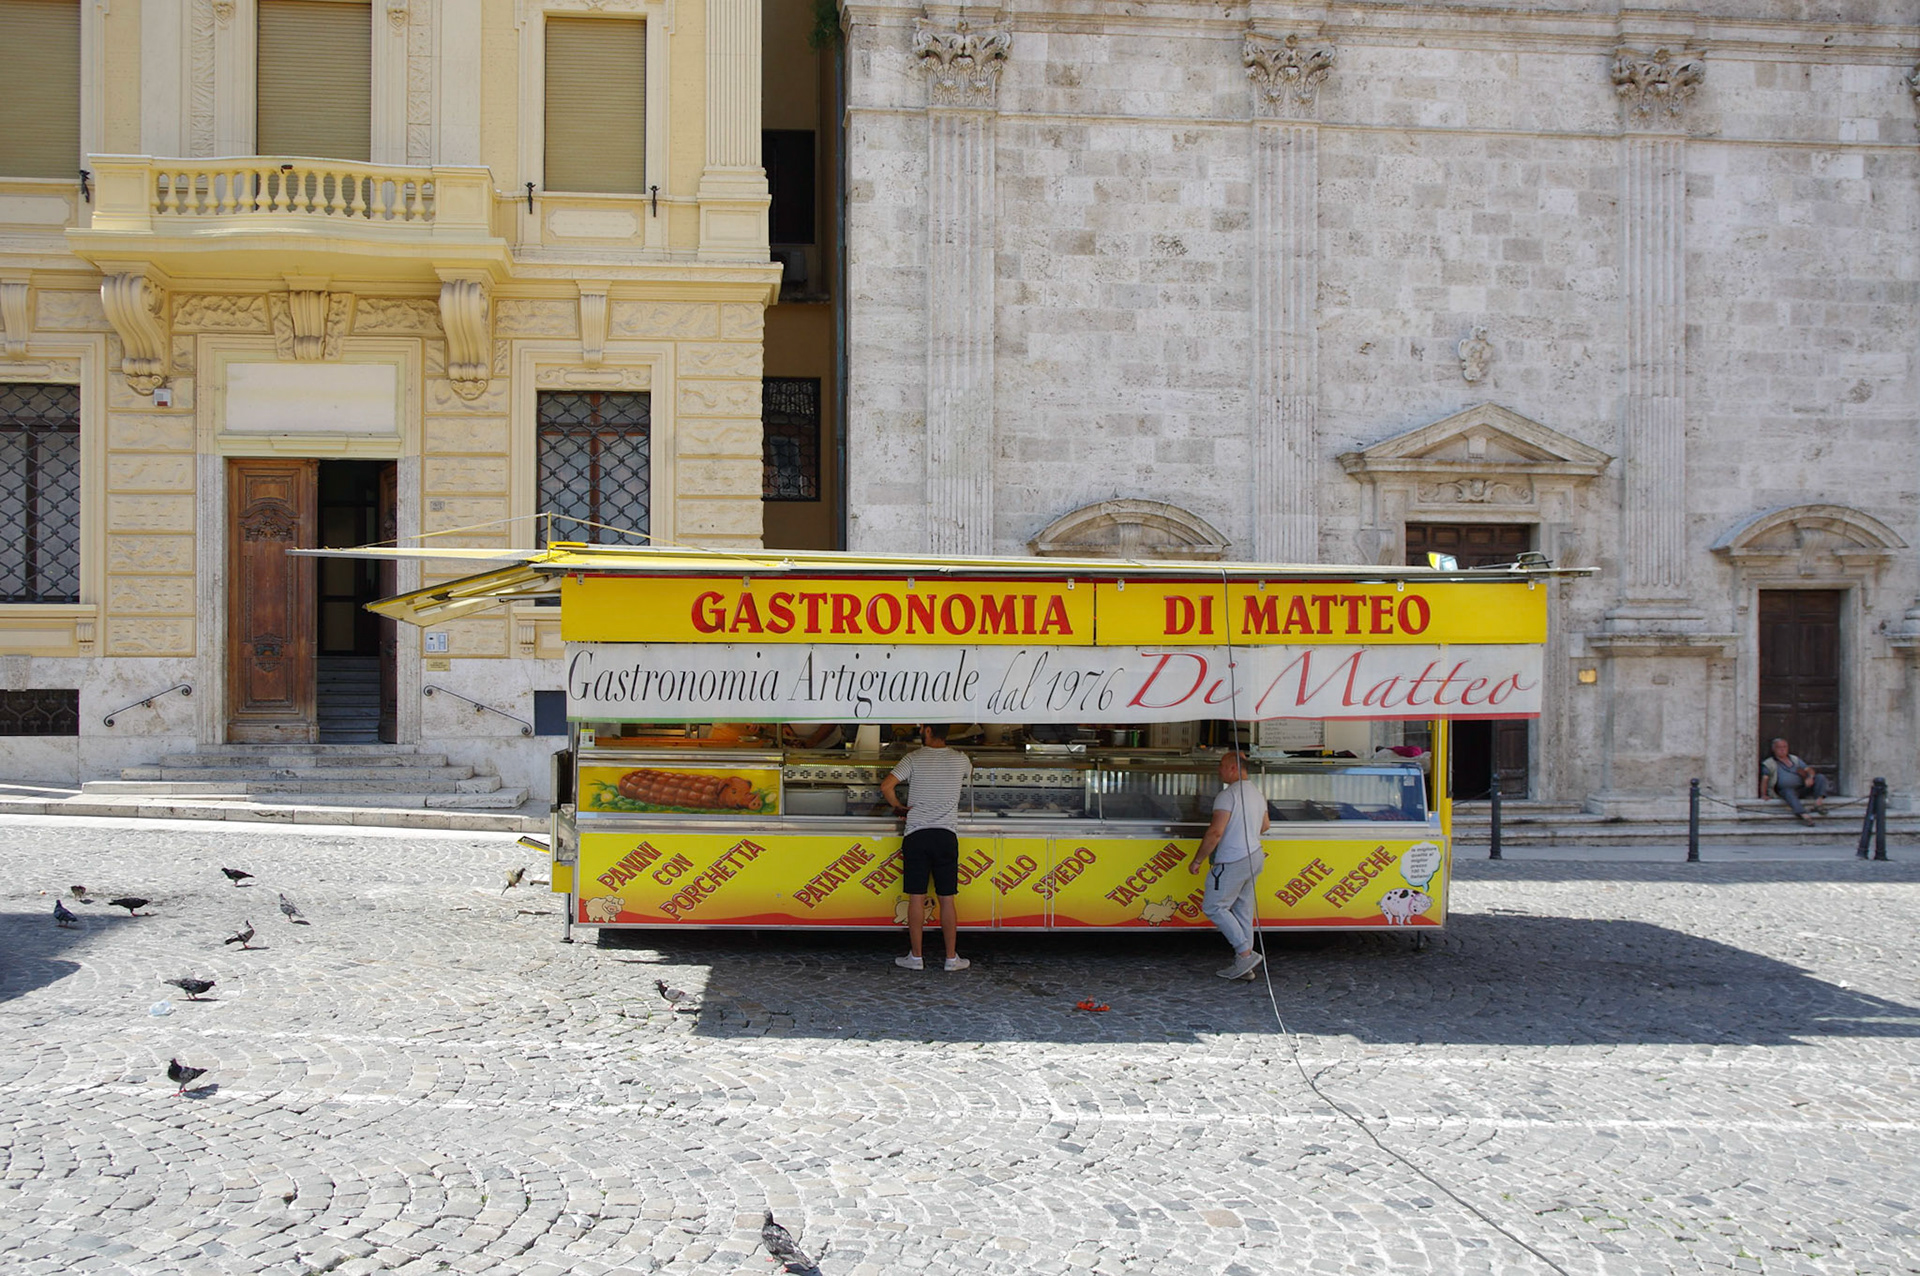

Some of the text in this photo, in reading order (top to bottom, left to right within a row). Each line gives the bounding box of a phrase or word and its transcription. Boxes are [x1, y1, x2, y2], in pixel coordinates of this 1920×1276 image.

[690, 589, 1075, 636] GASTRONOMIA
[1162, 593, 1432, 636] DI MATTEO
[567, 648, 1542, 718] Gastronomia Artigianale dal 1976 Di Matteo
[597, 841, 663, 893] PANINI
[652, 852, 695, 886] CON
[659, 838, 767, 921] PORCHETTA
[792, 842, 876, 909] PATATINE
[957, 849, 995, 886] OLLI
[990, 854, 1038, 896] ALLO
[1031, 846, 1097, 900] SPIEDO
[1104, 842, 1188, 908] TACCHINI
[1274, 857, 1335, 908] BIBITE
[1322, 845, 1398, 909] FRESCHE
